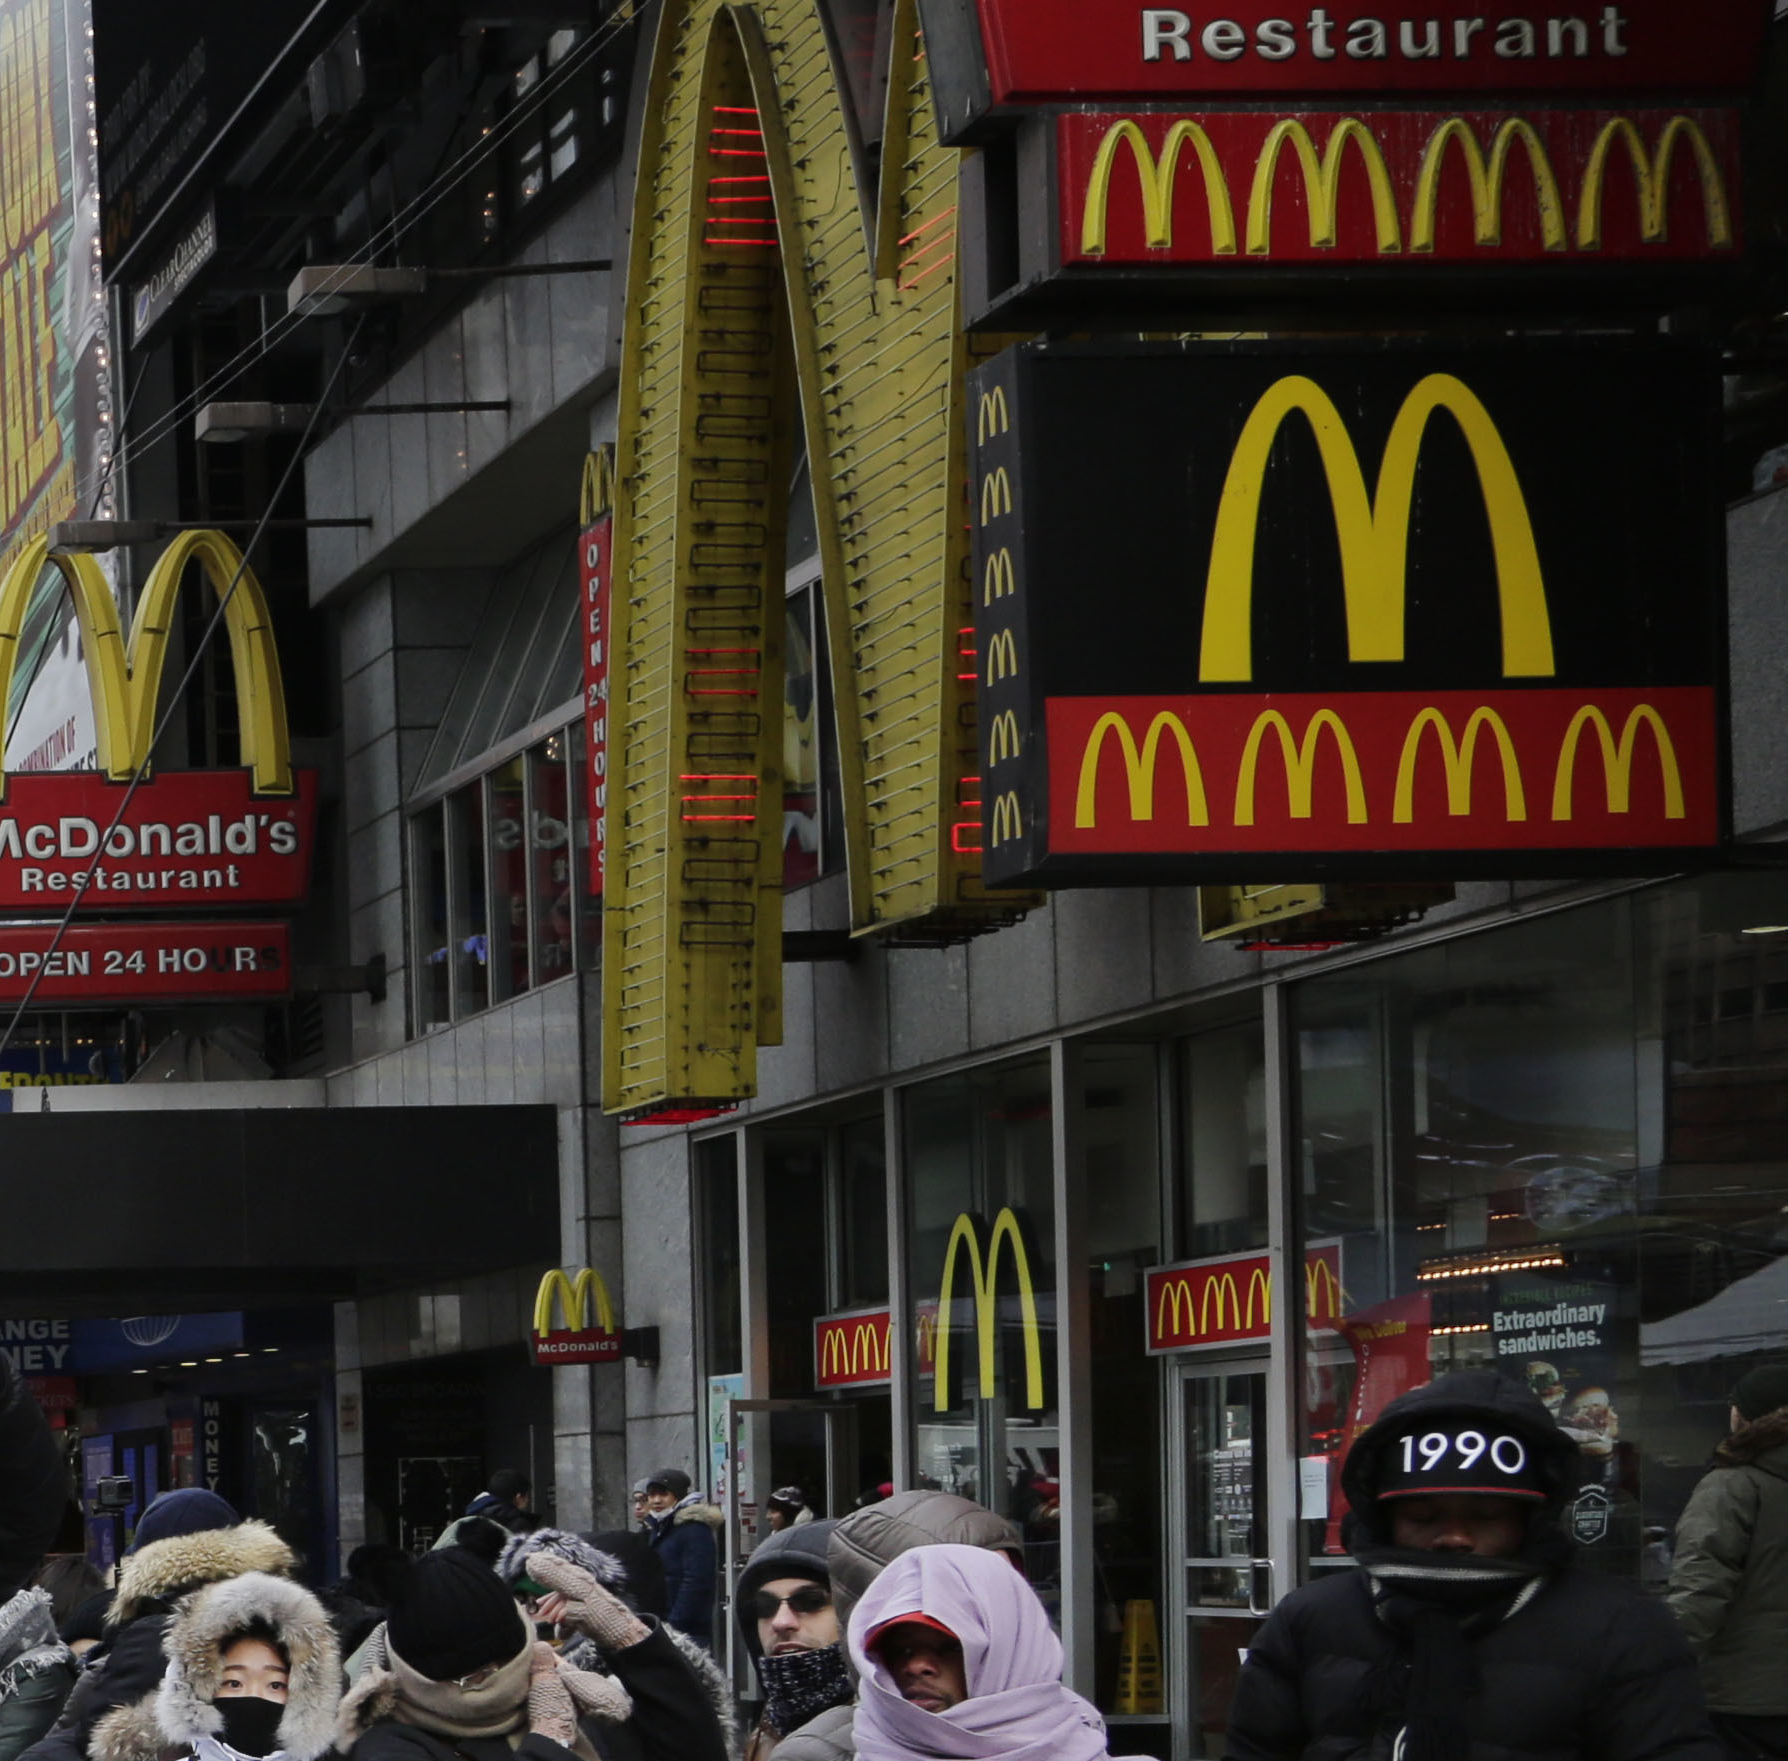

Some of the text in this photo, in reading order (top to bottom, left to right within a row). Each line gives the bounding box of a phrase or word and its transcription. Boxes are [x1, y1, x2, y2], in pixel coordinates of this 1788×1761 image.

[1141, 8, 1628, 63] Restaurant
[585, 544, 603, 667] OPEN
[587, 683, 608, 708] 24
[21, 863, 240, 892] Restaurant
[104, 949, 146, 975] 24
[1493, 1303, 1606, 1333] Extraordinary
[537, 1341, 618, 1353] McDonald's
[1498, 1329, 1601, 1355] sandwiches.
[1399, 1430, 1525, 1475] 1990
